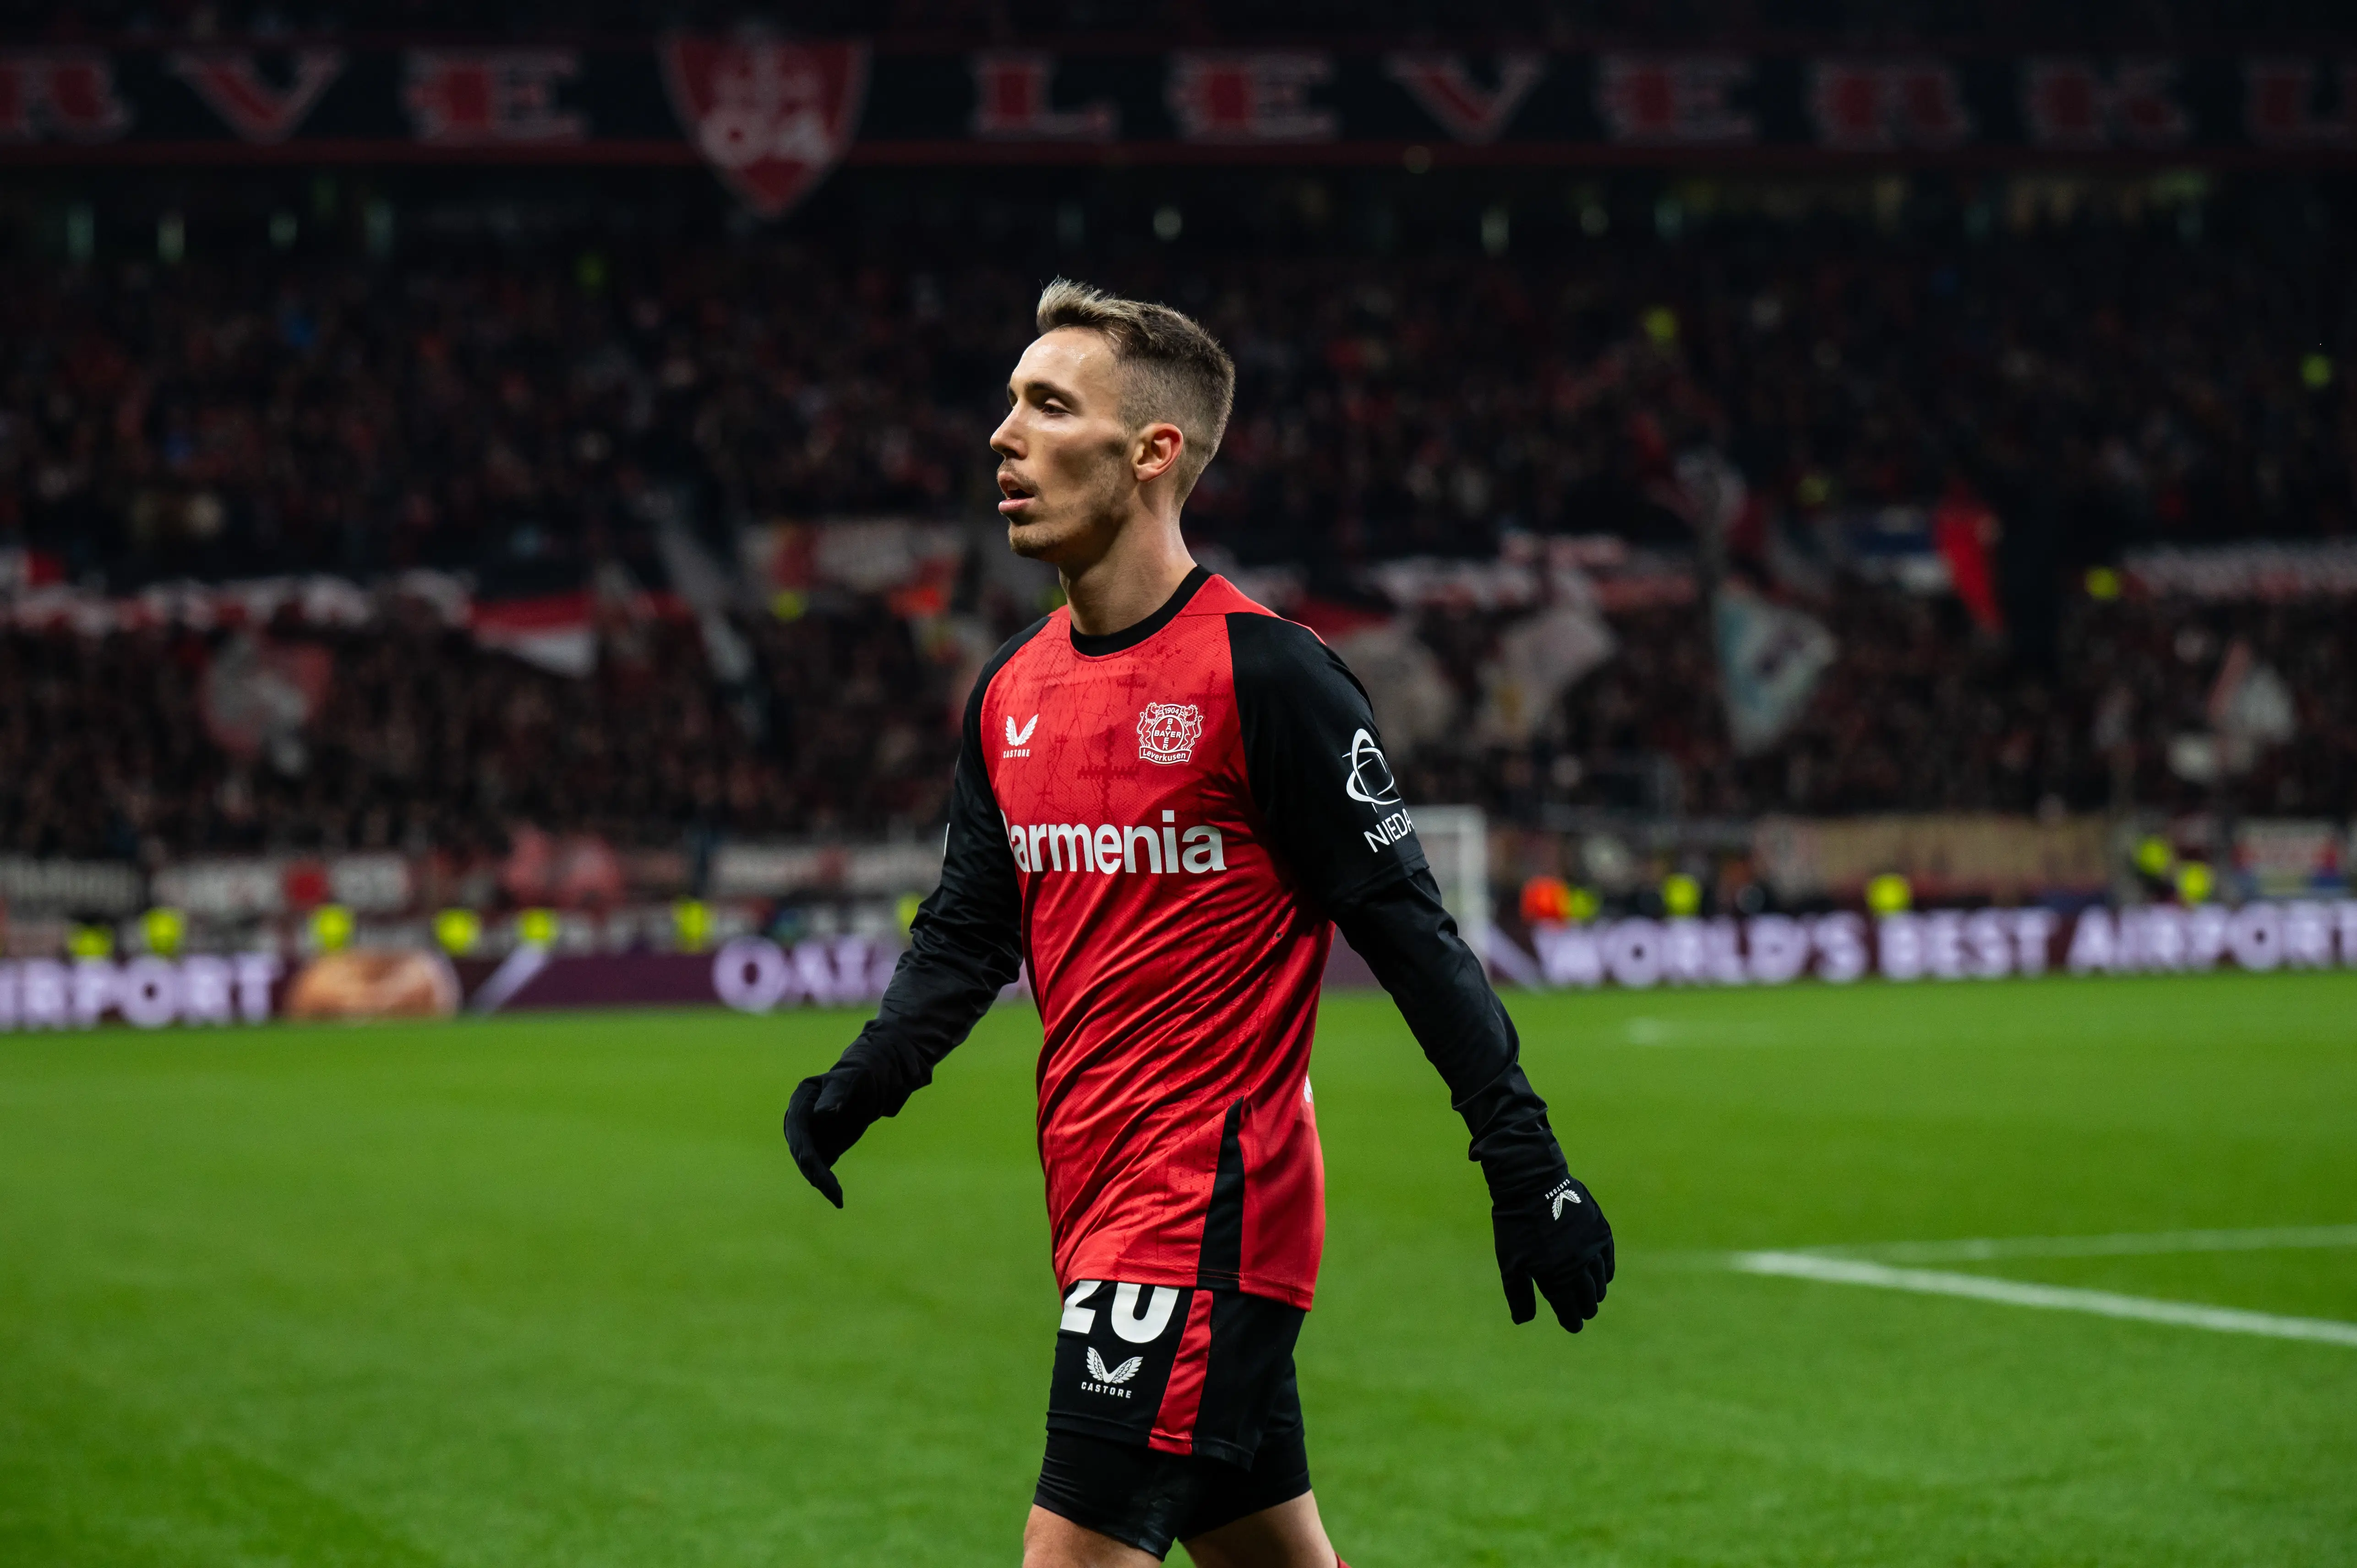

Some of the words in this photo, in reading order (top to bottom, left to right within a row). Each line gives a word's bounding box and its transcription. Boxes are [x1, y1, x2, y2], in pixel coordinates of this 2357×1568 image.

[1162, 718, 1173, 750] BAYER
[1003, 749, 1030, 758] CASTORE
[1143, 749, 1186, 762] Leverkusen
[1000, 809, 1227, 875] armenia
[1364, 808, 1414, 853] NIEDA
[1877, 907, 2061, 981] BEST
[1545, 1179, 1570, 1200] CASTORE
[1060, 1280, 1180, 1343] 20
[1081, 1382, 1132, 1399] CASTORE
